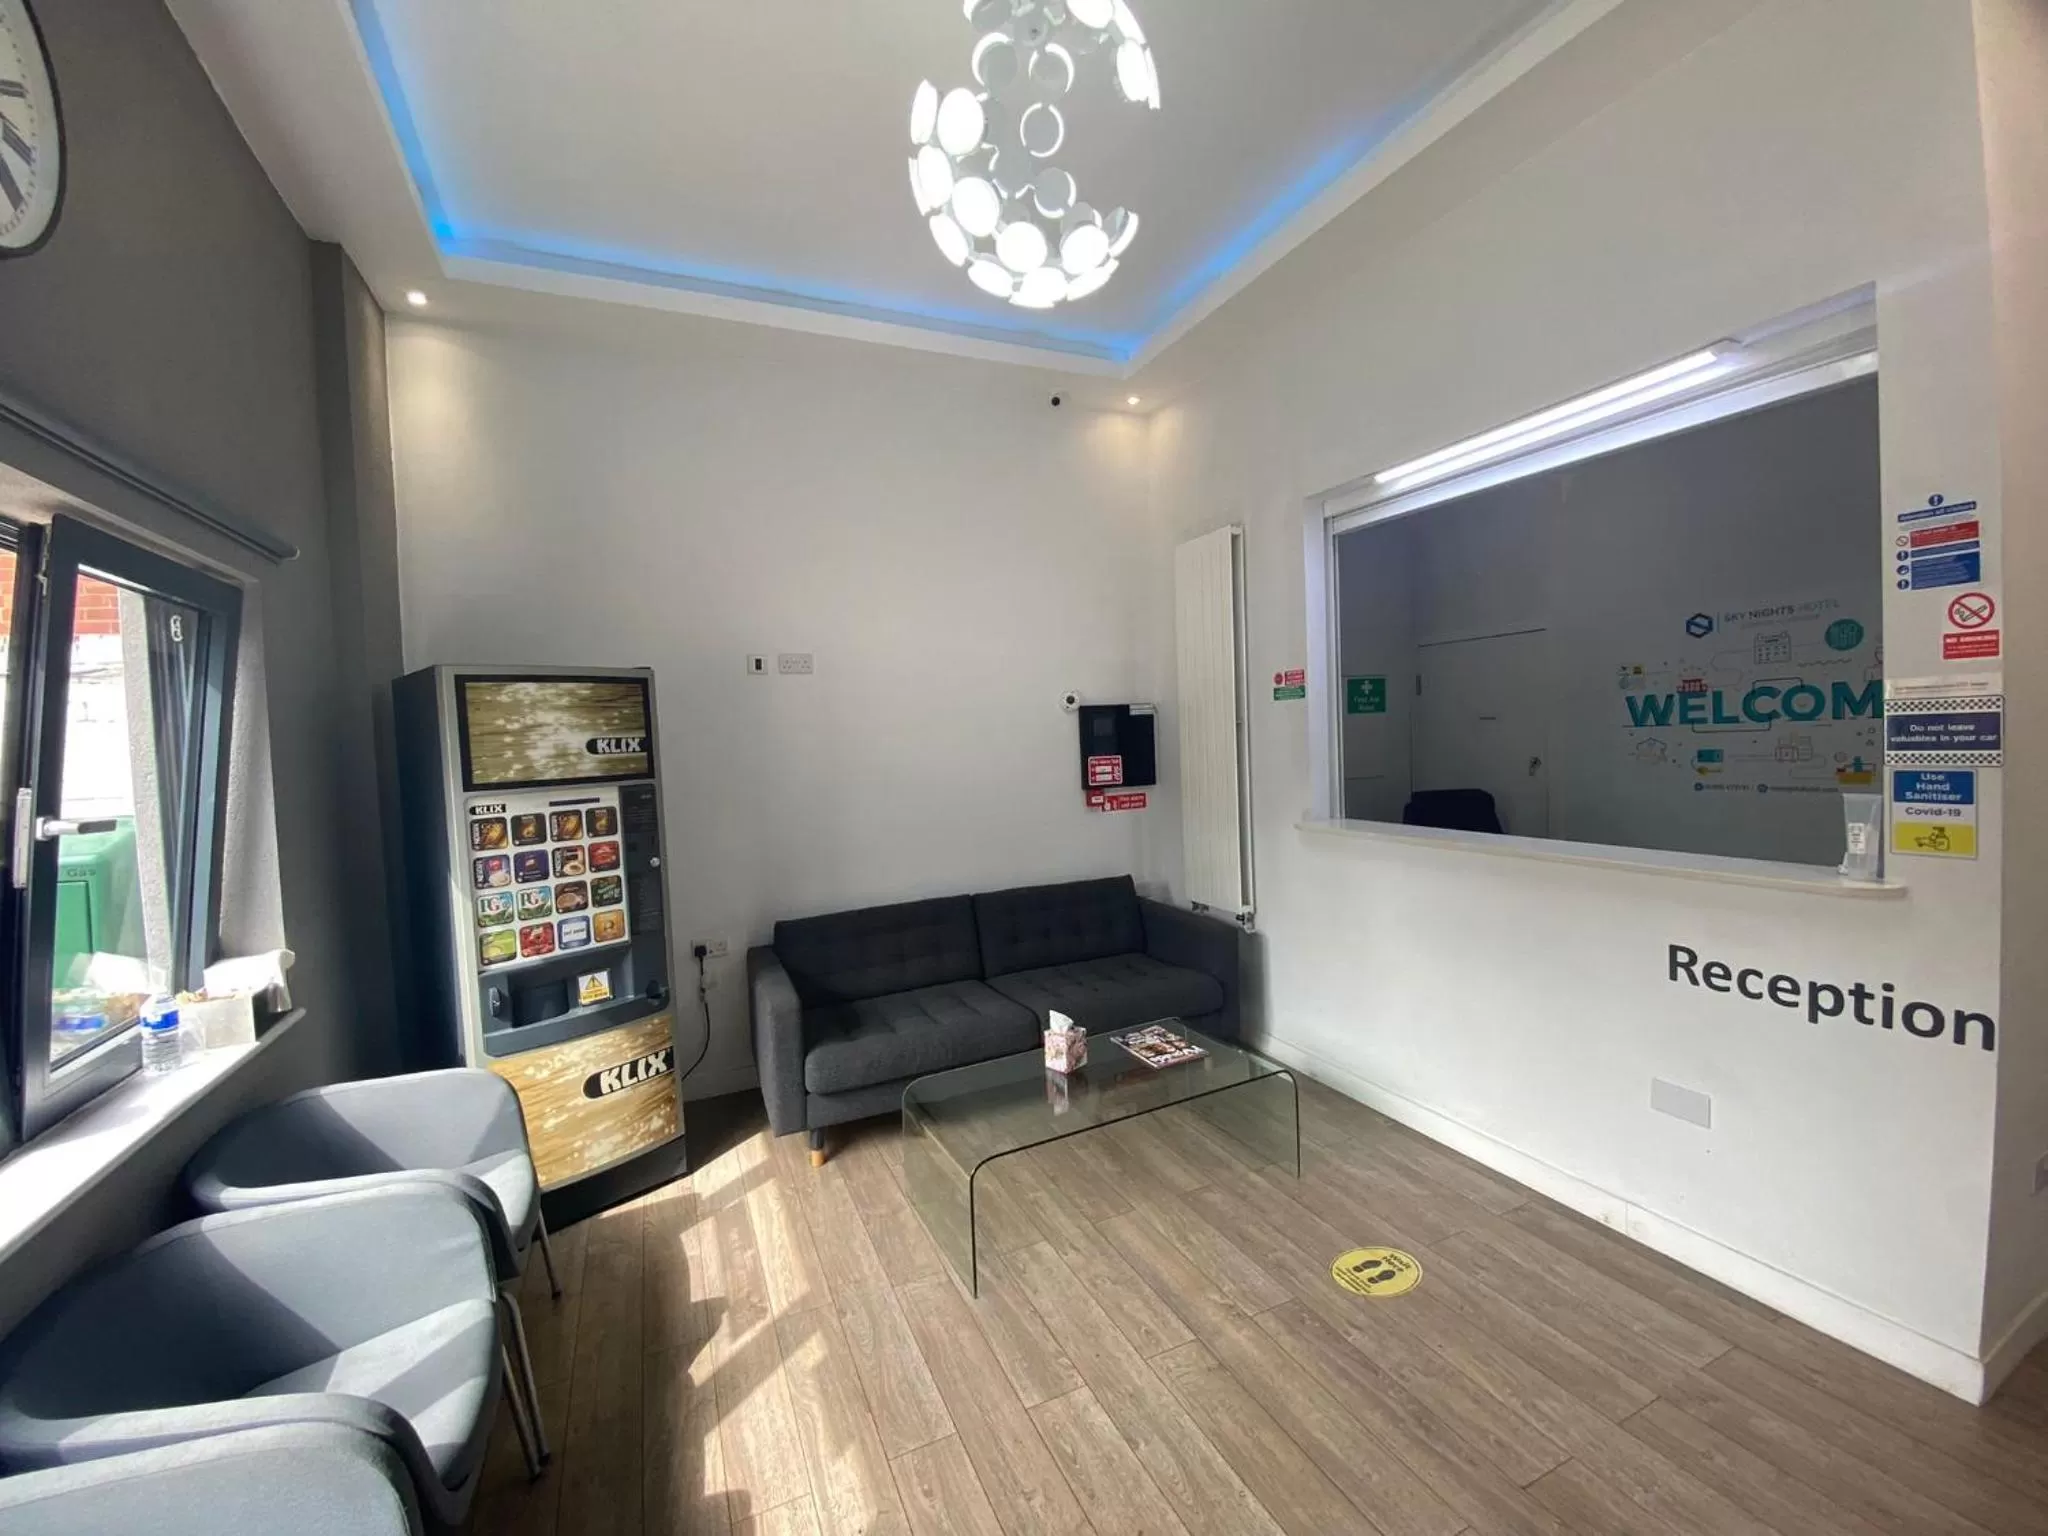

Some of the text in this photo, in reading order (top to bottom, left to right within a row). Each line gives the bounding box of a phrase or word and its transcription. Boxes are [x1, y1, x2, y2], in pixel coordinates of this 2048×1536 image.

[1724, 612, 1746, 623] SKY
[1749, 605, 1795, 620] NIGHTS
[1909, 724, 1925, 732] Do
[1947, 723, 1976, 731] leave
[1890, 734, 1937, 742] valuables
[1952, 734, 1977, 743] your
[596, 737, 641, 753] KLIX
[1920, 773, 1945, 781] Use
[1916, 782, 1950, 791] Hand
[1904, 791, 1962, 801] Sanitiser
[474, 804, 503, 815] KLIX
[1904, 806, 1962, 817] Covid-19
[1668, 944, 1996, 1052] Reception
[600, 1048, 668, 1095] KLIX
